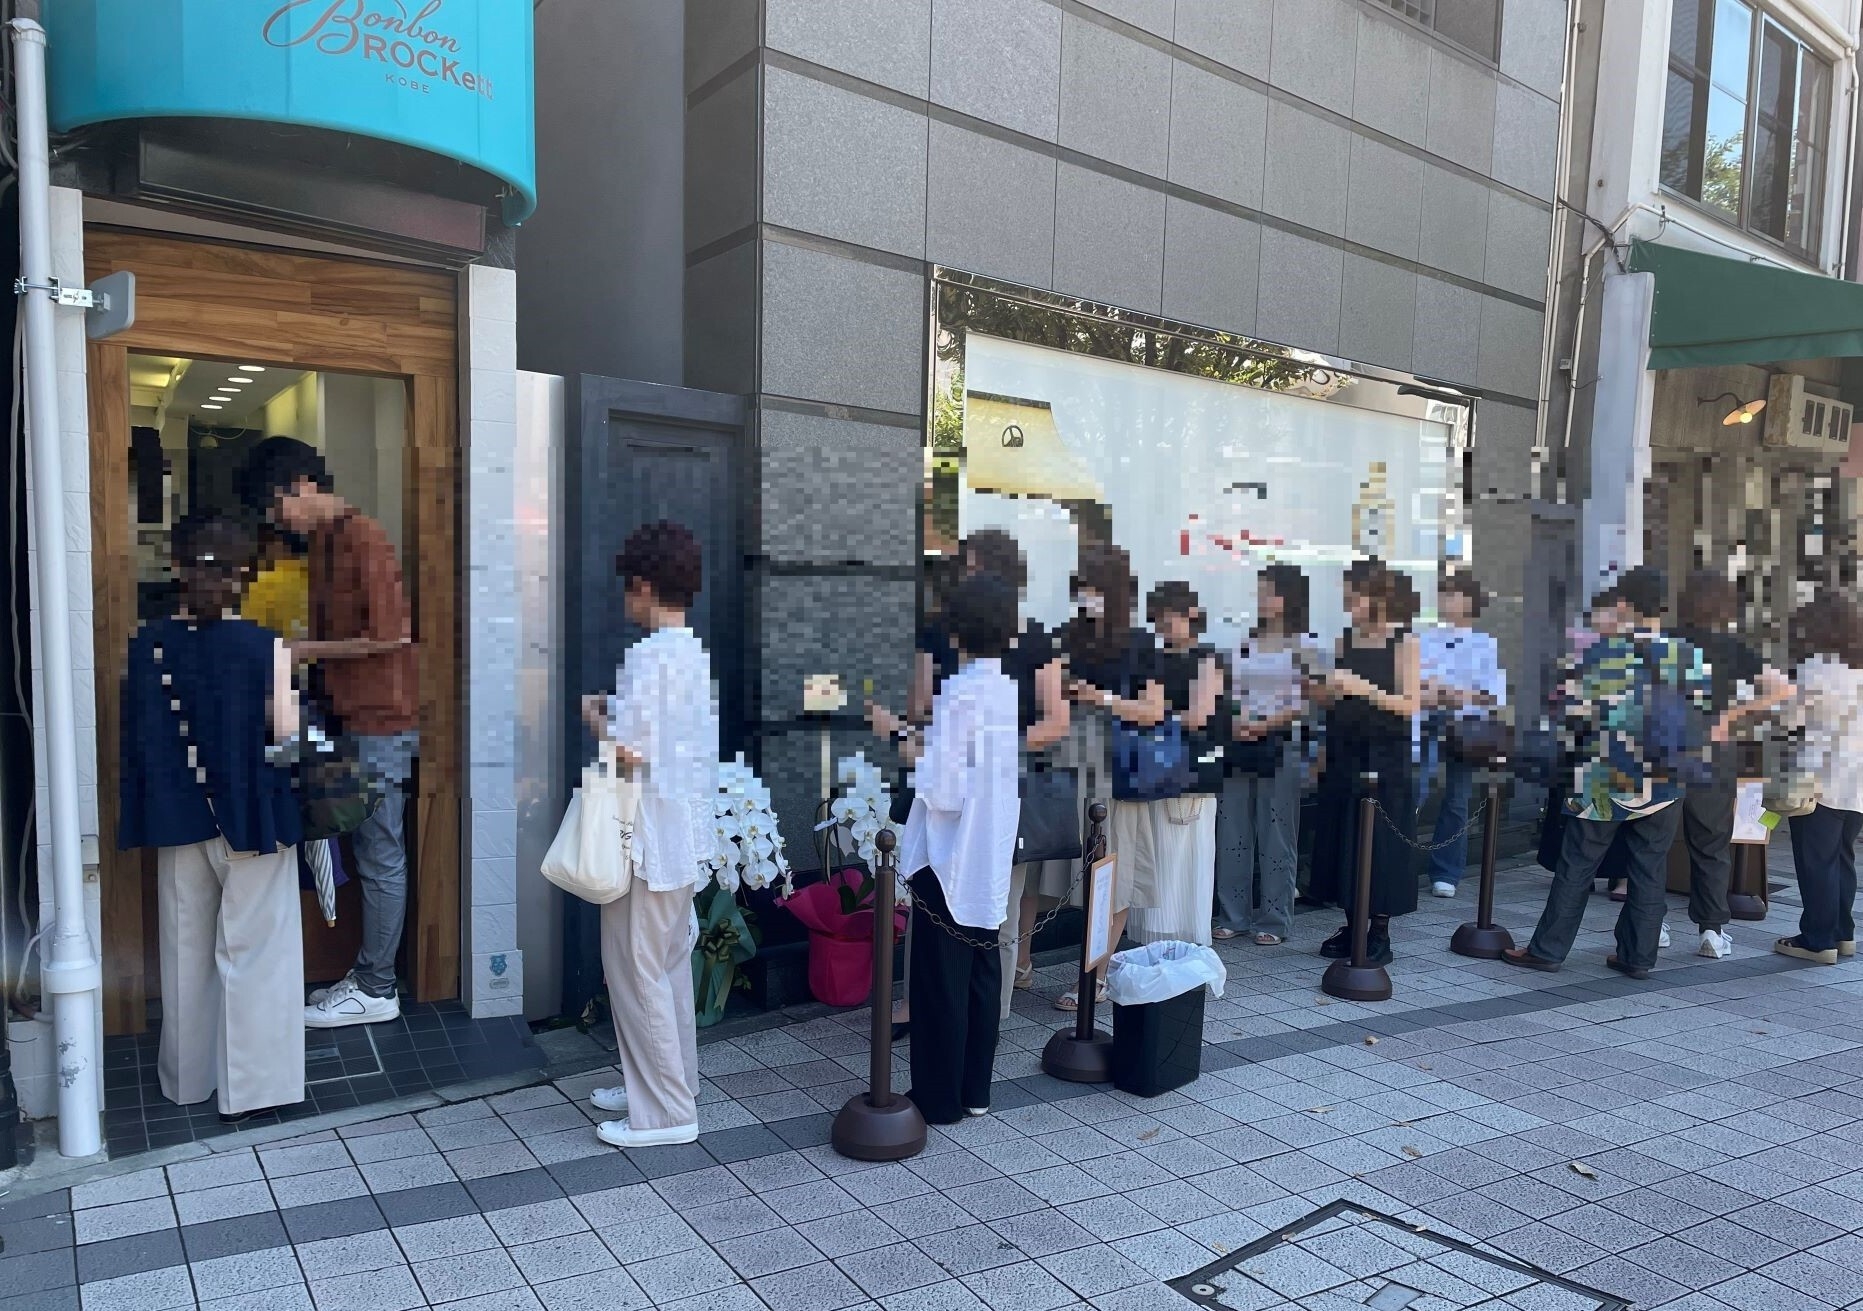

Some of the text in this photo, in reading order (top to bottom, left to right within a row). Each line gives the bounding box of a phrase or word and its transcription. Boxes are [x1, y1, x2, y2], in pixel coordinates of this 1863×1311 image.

[263, 0, 461, 54] Bonbon
[363, 33, 494, 101] ROCKett
[385, 73, 430, 94] KOBE
